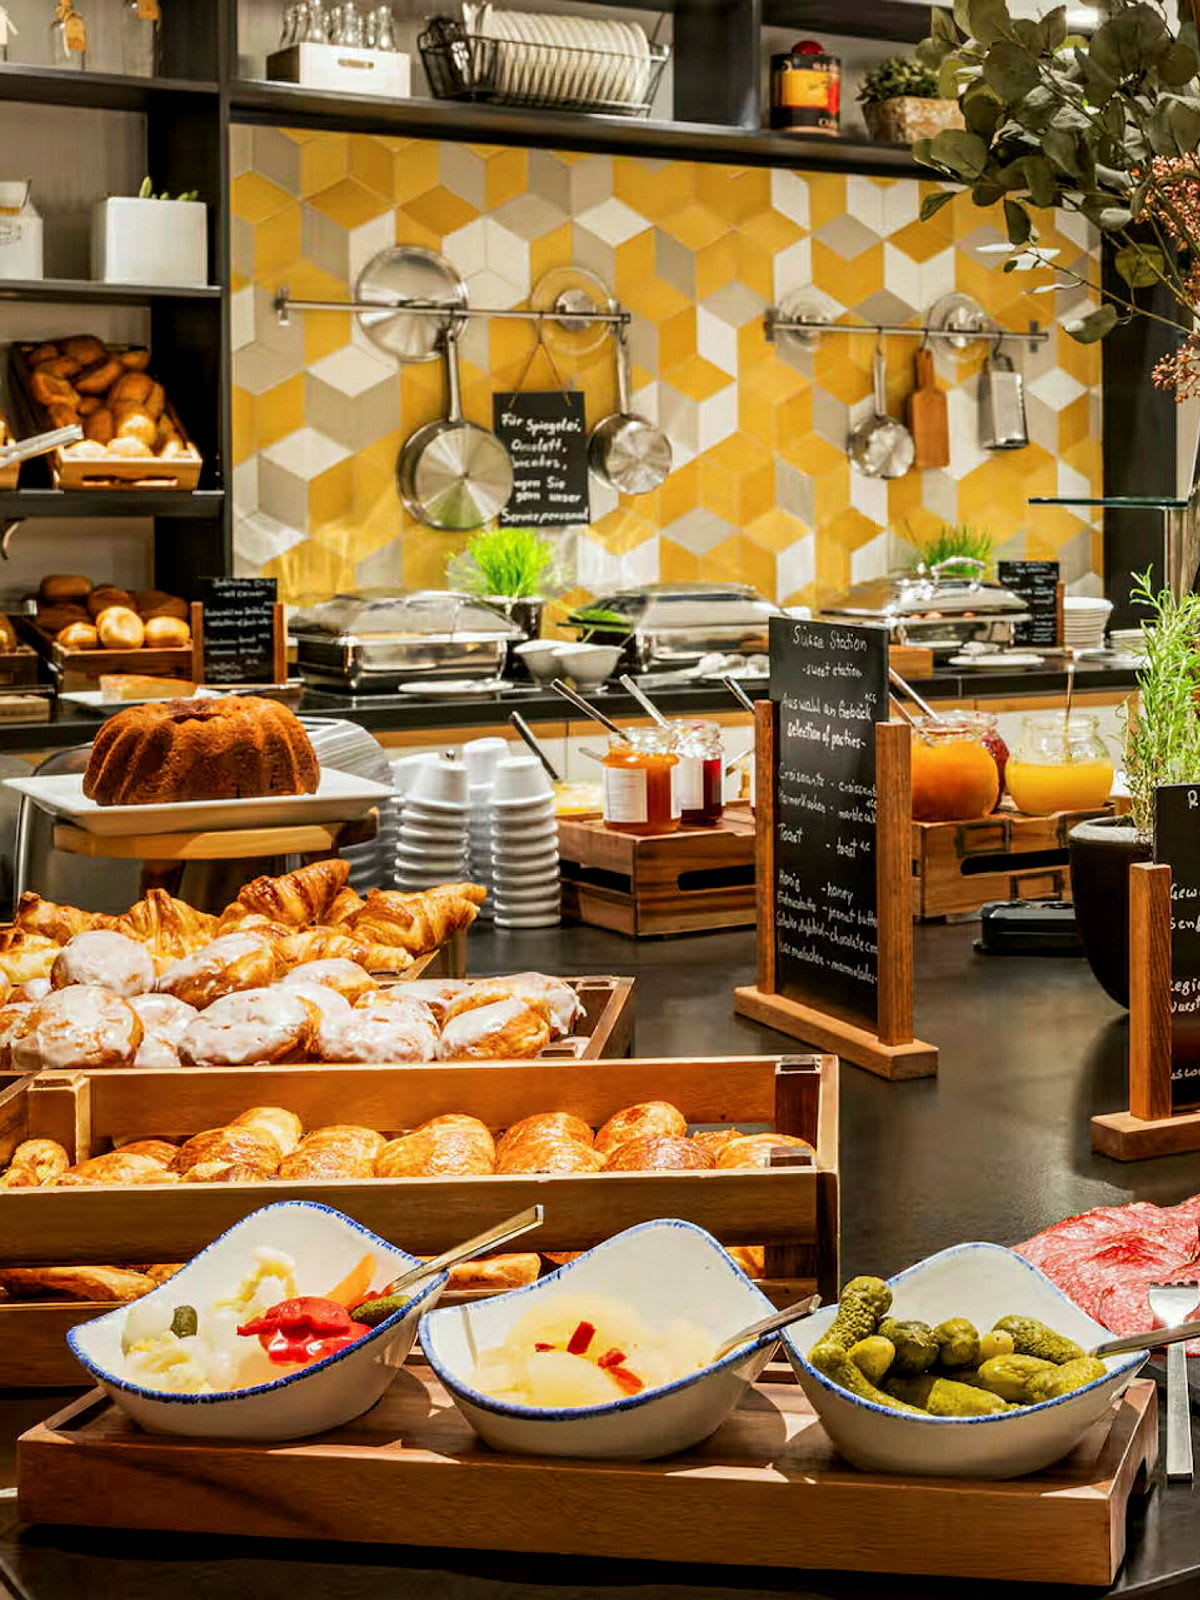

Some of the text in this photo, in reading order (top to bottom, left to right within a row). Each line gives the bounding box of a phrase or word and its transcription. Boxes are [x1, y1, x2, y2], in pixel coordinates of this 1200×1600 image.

[546, 475, 567, 490] Sie
[829, 630, 868, 652] Station
[823, 703, 836, 717] an
[786, 718, 821, 741] selection
[821, 723, 831, 747] of
[778, 821, 803, 844] Toast
[836, 835, 858, 859] toast
